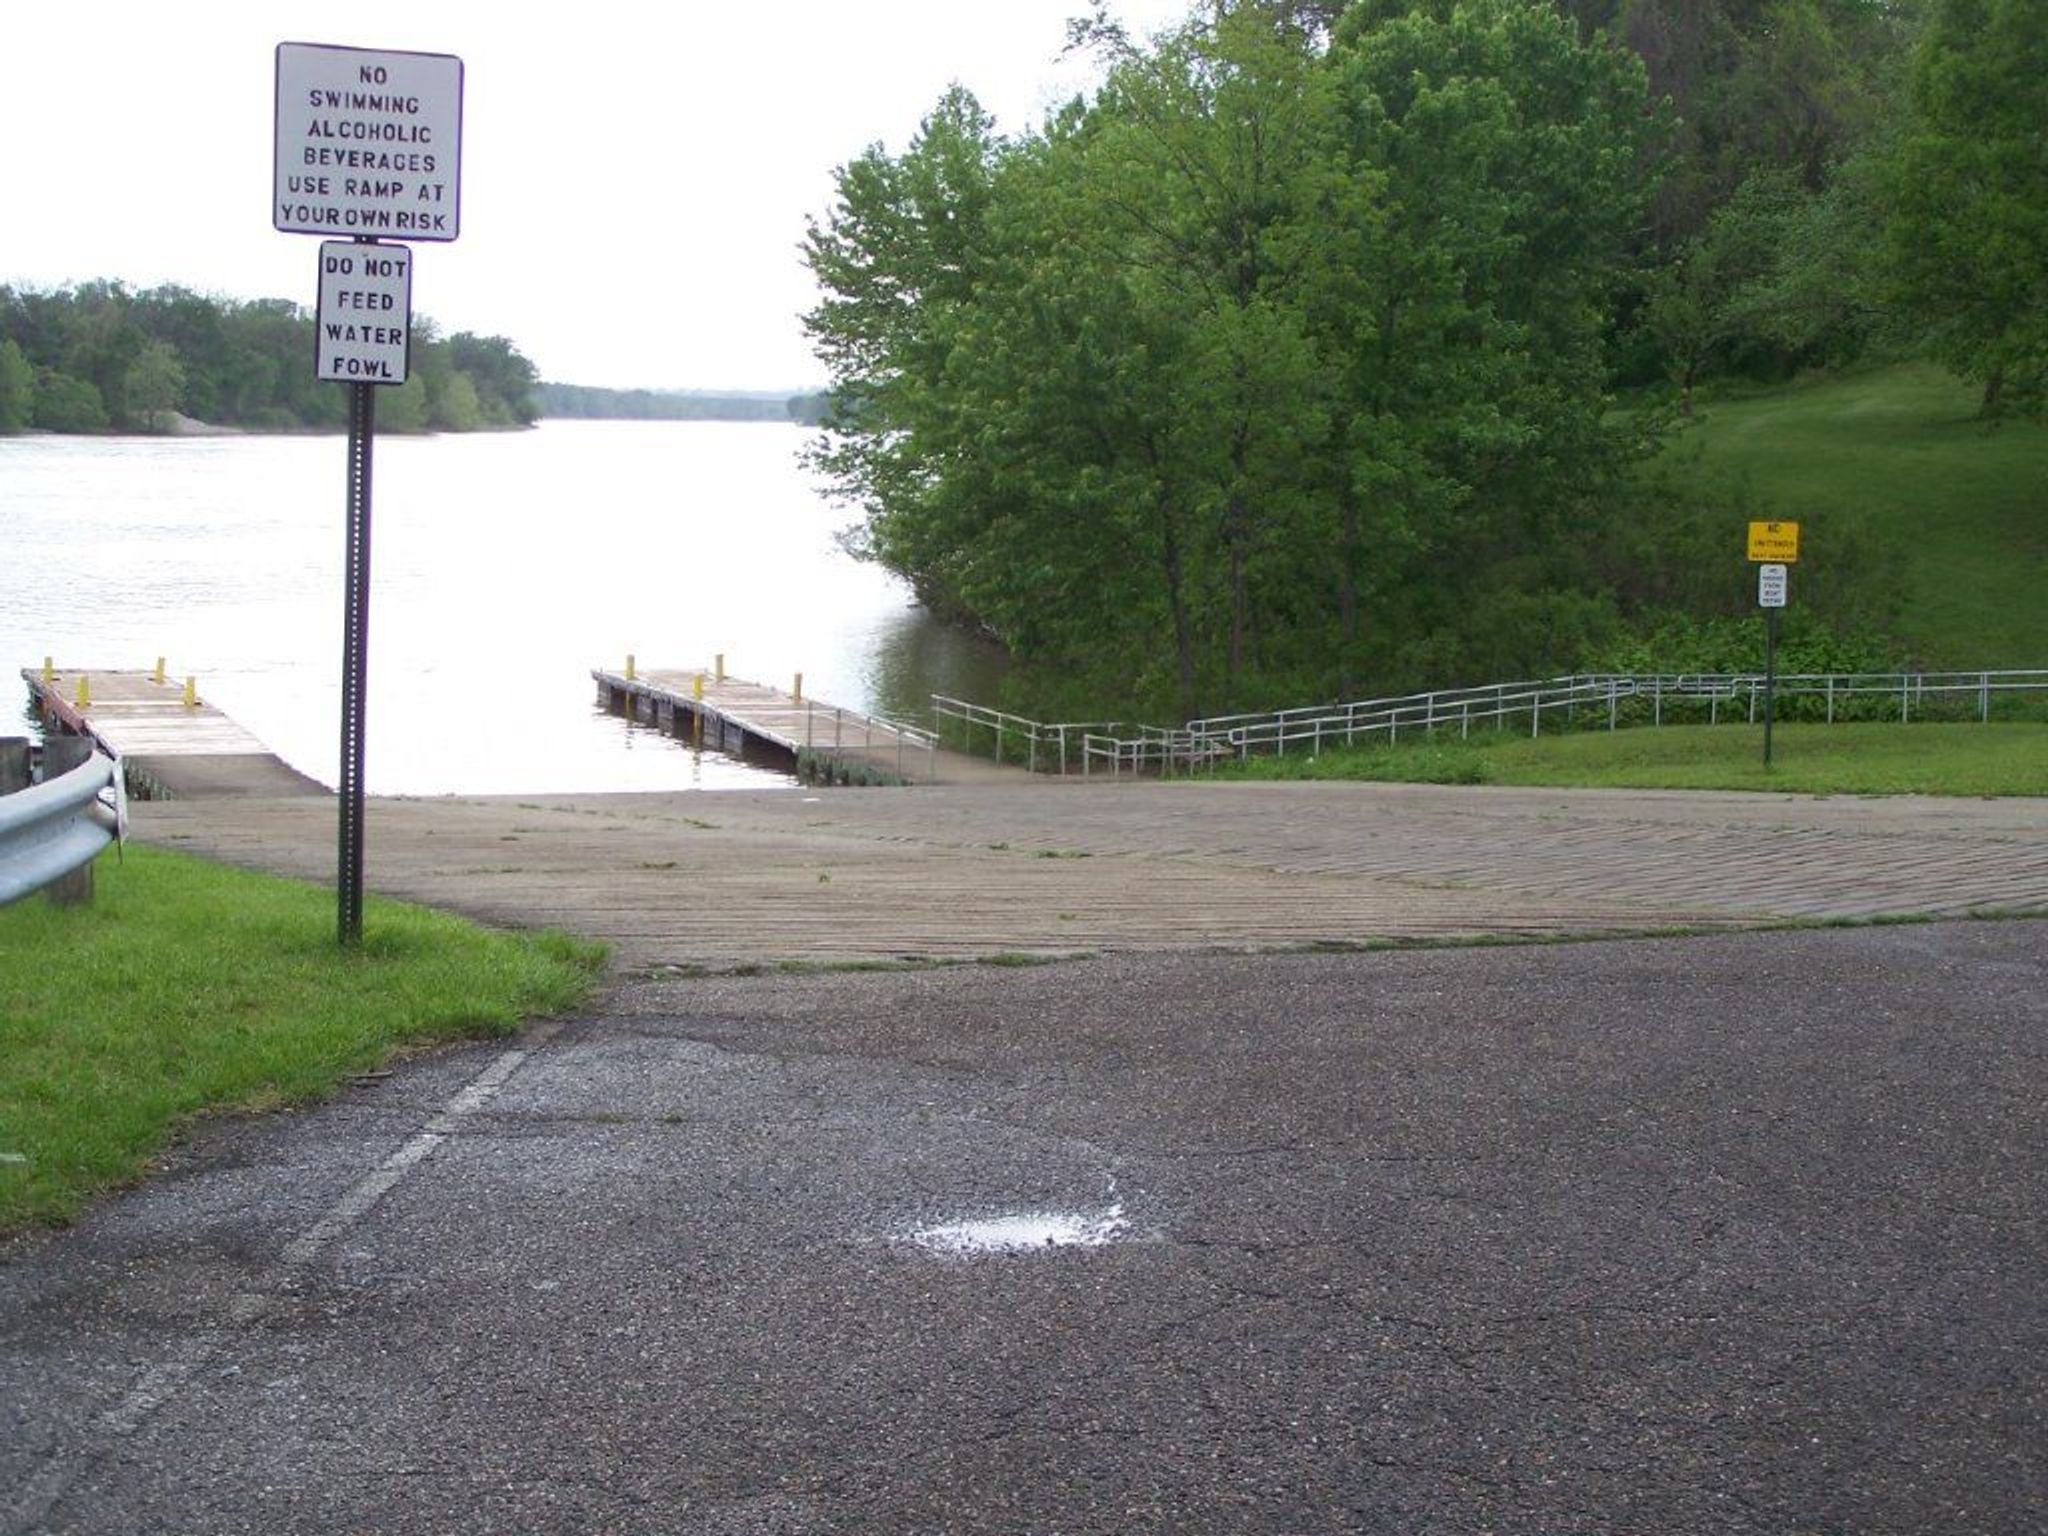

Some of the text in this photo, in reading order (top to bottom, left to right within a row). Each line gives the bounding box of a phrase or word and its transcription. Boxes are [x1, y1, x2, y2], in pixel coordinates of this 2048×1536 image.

[359, 65, 387, 84] NO
[309, 90, 419, 114] SWIMMING
[307, 120, 432, 143] ALCOHOLIC
[304, 147, 436, 172] BEVERAGES
[288, 176, 444, 201] USE RAMP AT
[282, 204, 447, 231] YOUR OWN RISK
[326, 257, 406, 277] DO NOT
[338, 291, 394, 310] FEED
[326, 323, 402, 345] WATER
[333, 357, 391, 377] FOWL
